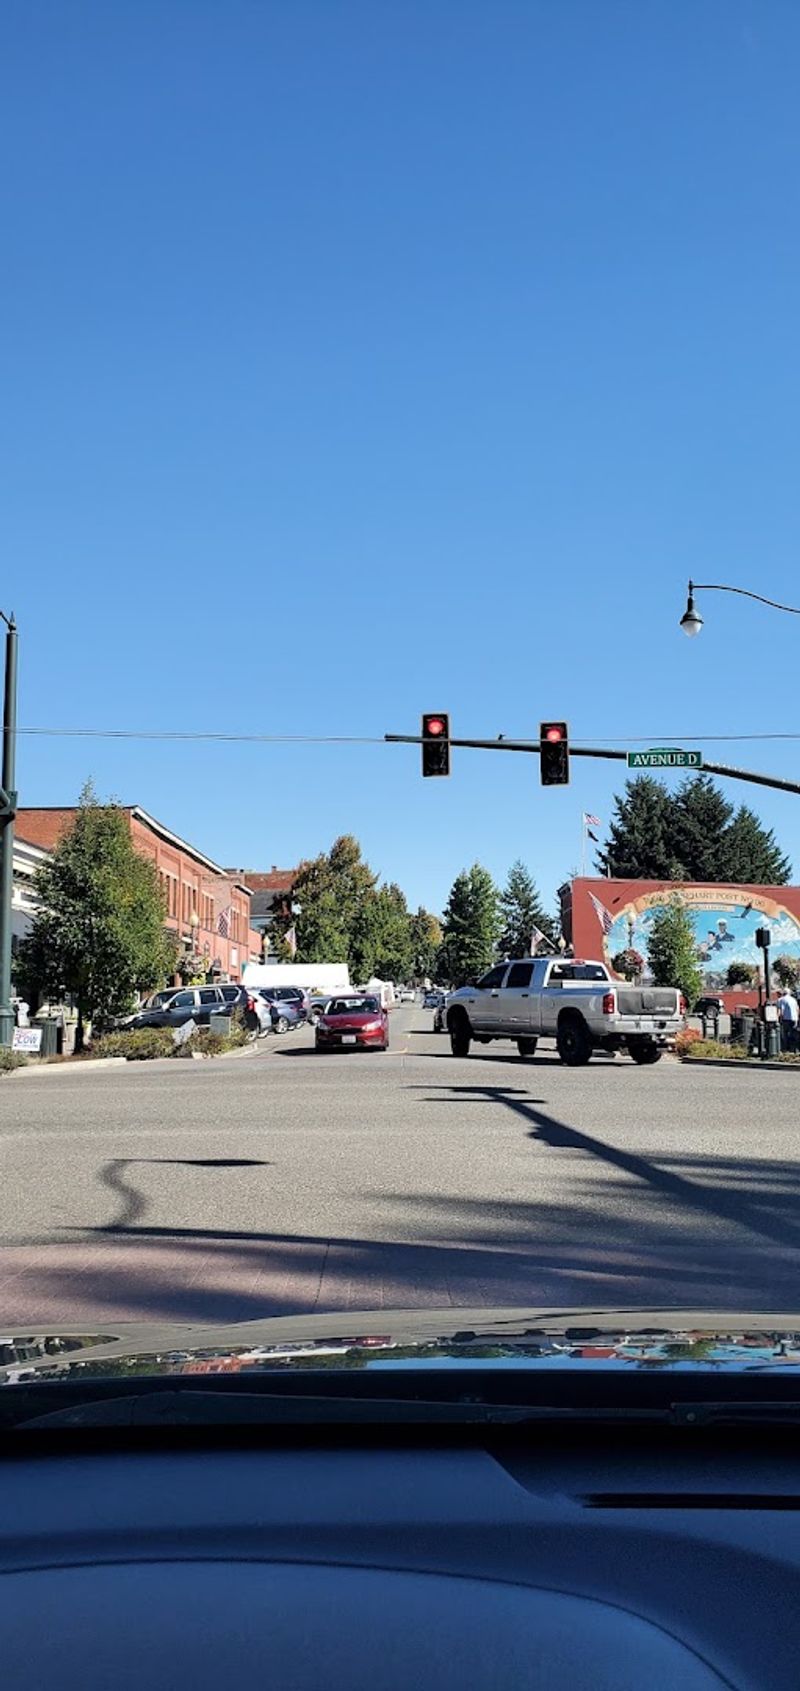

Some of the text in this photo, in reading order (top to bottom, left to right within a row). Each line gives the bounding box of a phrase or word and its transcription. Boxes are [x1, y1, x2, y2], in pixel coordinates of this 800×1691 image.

[633, 754, 697, 765] AVENUE D
[717, 892, 738, 901] POST
